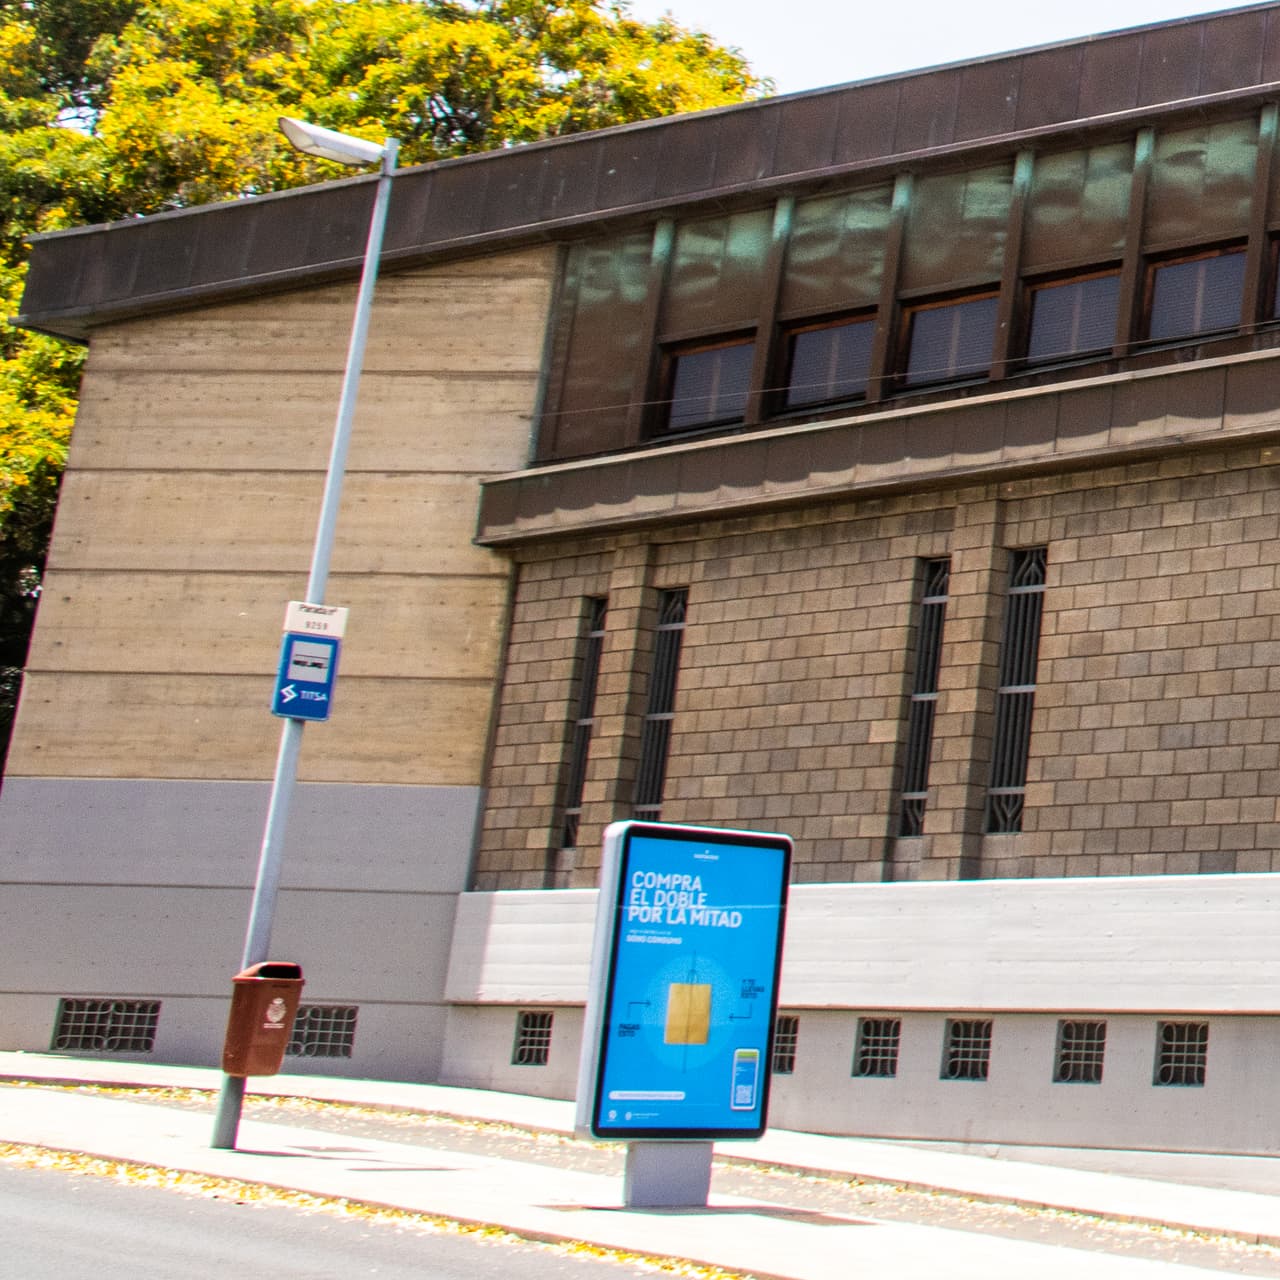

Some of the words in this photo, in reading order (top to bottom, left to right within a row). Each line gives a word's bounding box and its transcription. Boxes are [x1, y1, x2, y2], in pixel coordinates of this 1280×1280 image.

[300, 690, 328, 701] TITSA
[632, 871, 702, 891] COMPRA
[630, 888, 650, 905] EL
[653, 890, 708, 908] DOBLE
[628, 906, 662, 923] POR
[666, 908, 687, 924] LA
[690, 910, 742, 928] MITAD
